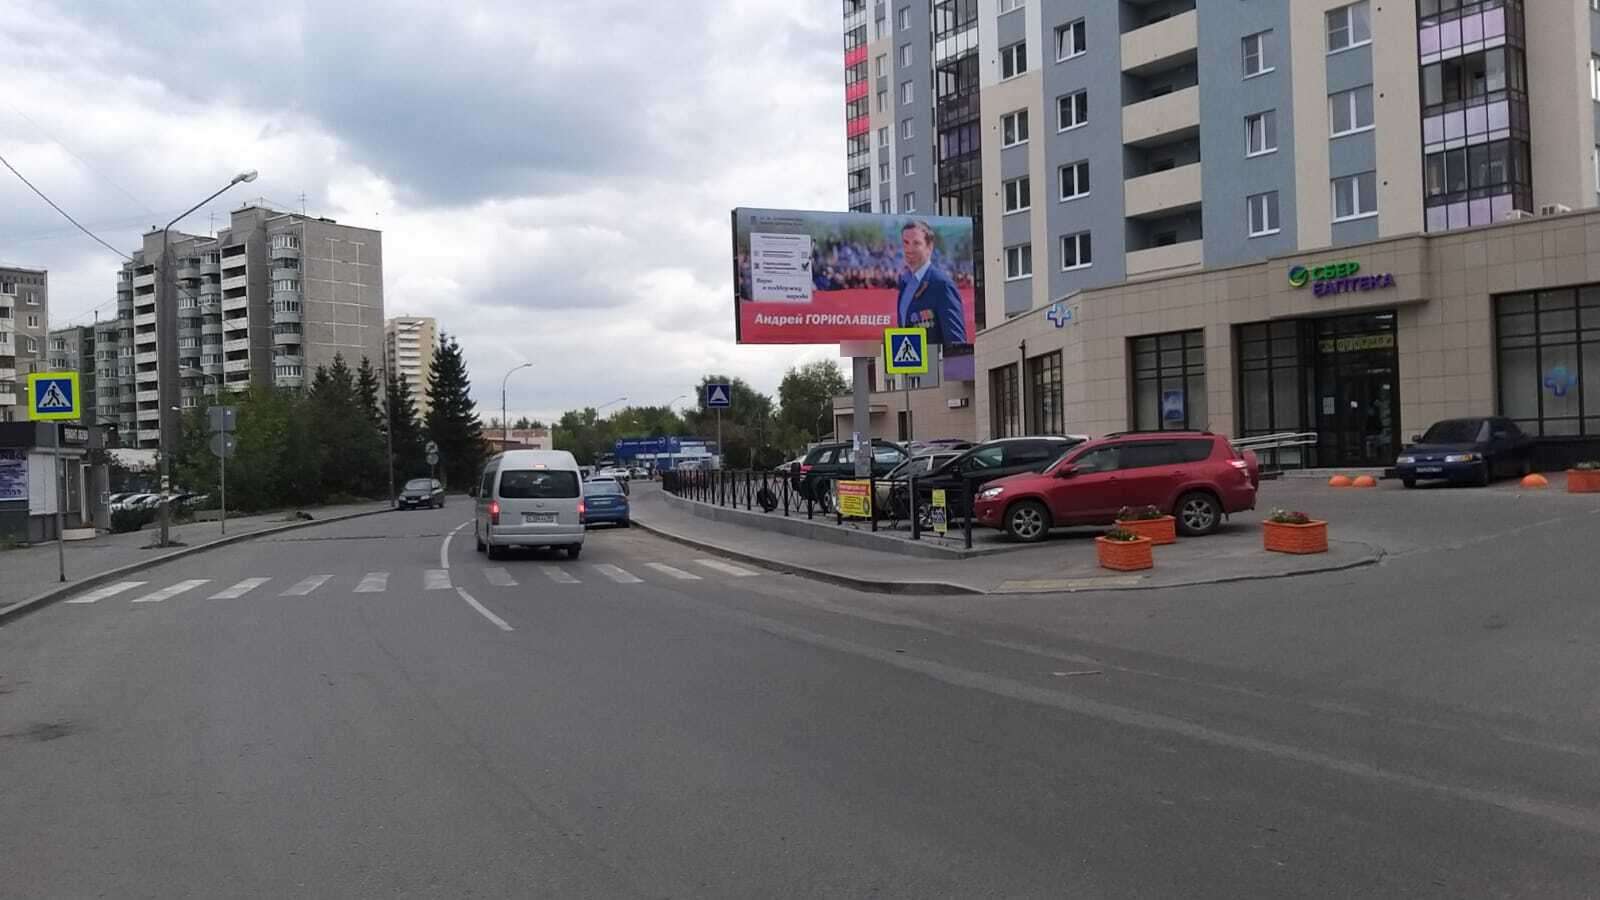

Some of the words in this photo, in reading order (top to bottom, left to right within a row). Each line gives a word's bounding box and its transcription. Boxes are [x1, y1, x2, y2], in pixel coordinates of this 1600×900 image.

[1312, 262, 1360, 281] СБЕР
[1313, 273, 1396, 298] ЕАПТЕКА
[754, 313, 804, 326] Андрей
[805, 313, 891, 326] ГОРИСЛАВЦЕВ
